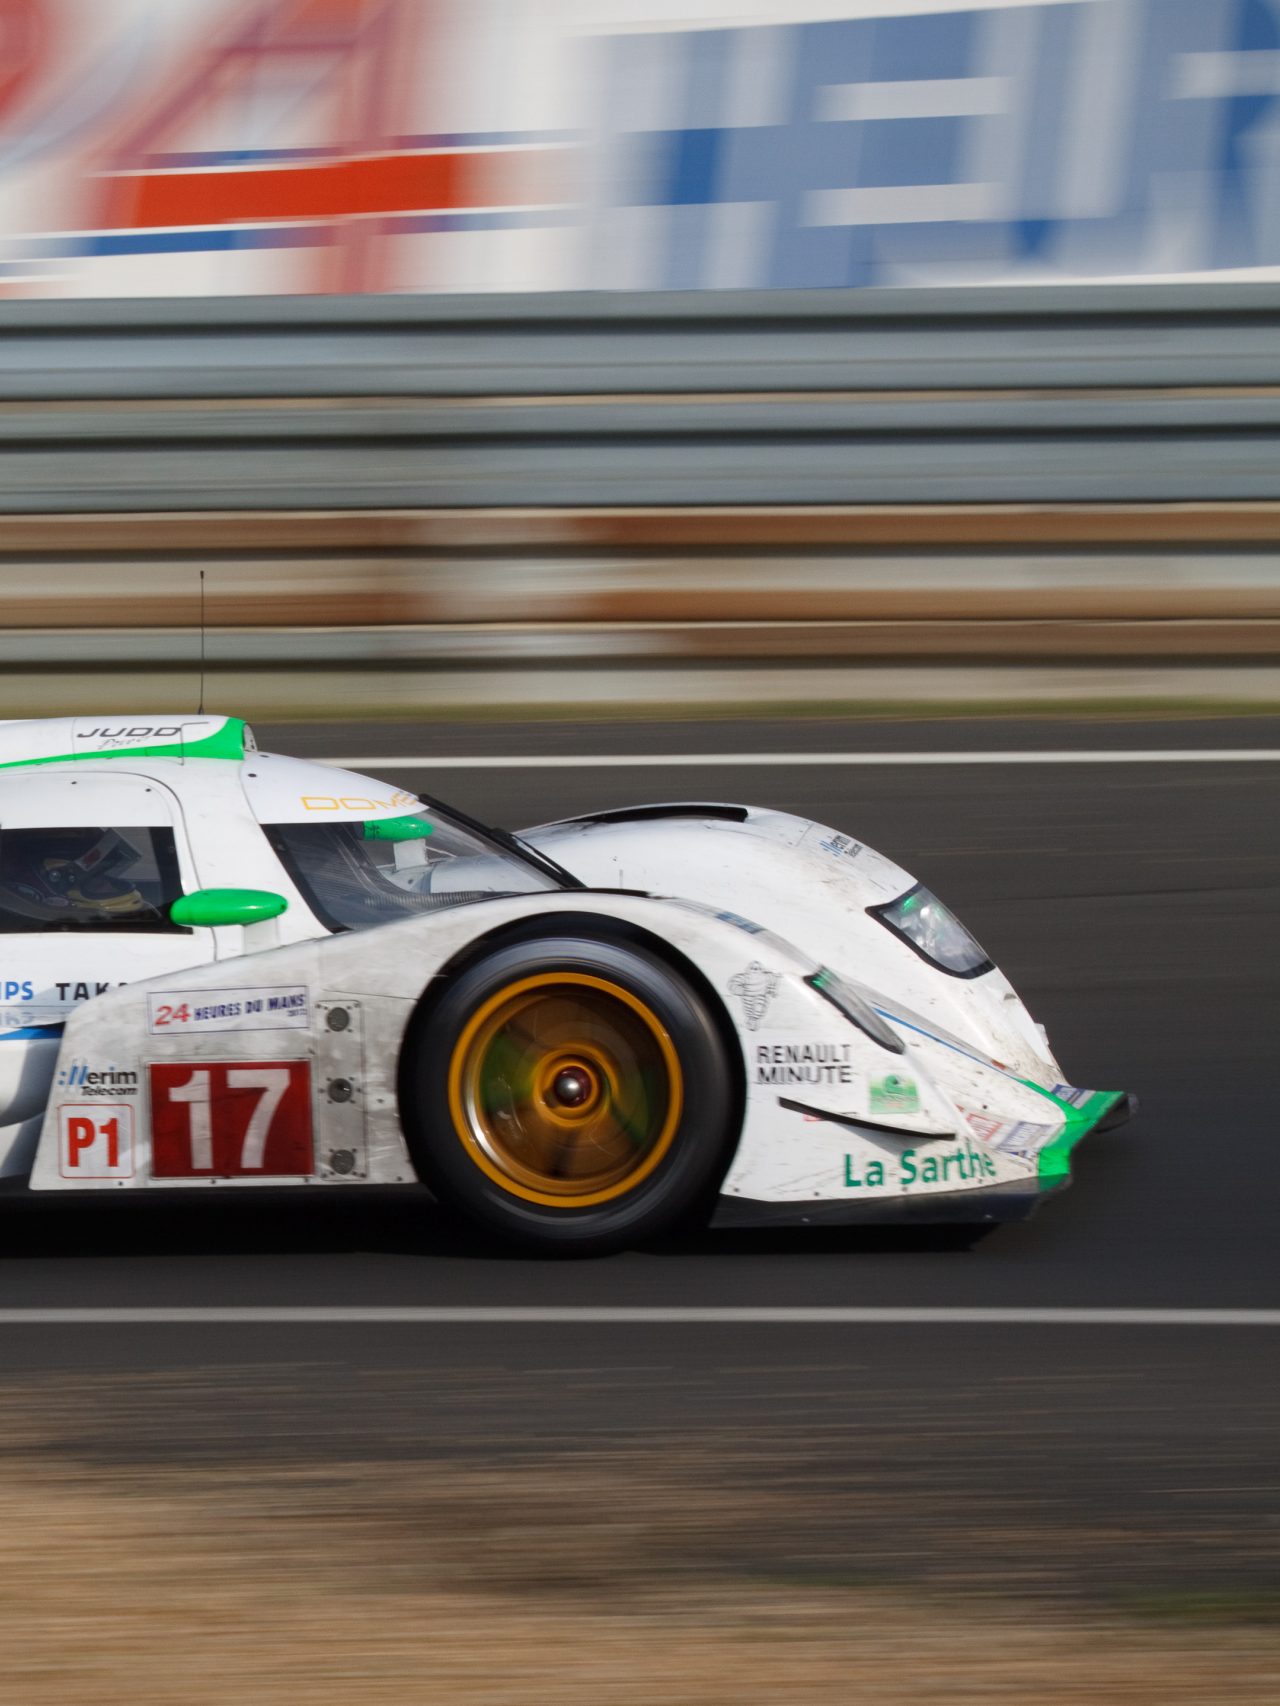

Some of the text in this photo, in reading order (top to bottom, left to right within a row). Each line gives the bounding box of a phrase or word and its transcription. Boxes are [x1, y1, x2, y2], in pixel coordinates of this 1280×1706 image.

[76, 727, 182, 738] JUDD
[55, 982, 128, 1001] TAK
[155, 993, 307, 1027] 24 HEURES DU MANS
[757, 1043, 851, 1064] RENAULT
[757, 1065, 852, 1085] MINUTE
[81, 1085, 138, 1097] Telecom
[168, 1068, 291, 1170] 17
[67, 1117, 119, 1167] P1
[844, 1153, 884, 1188] La
[899, 1136, 997, 1186] Sarthe
